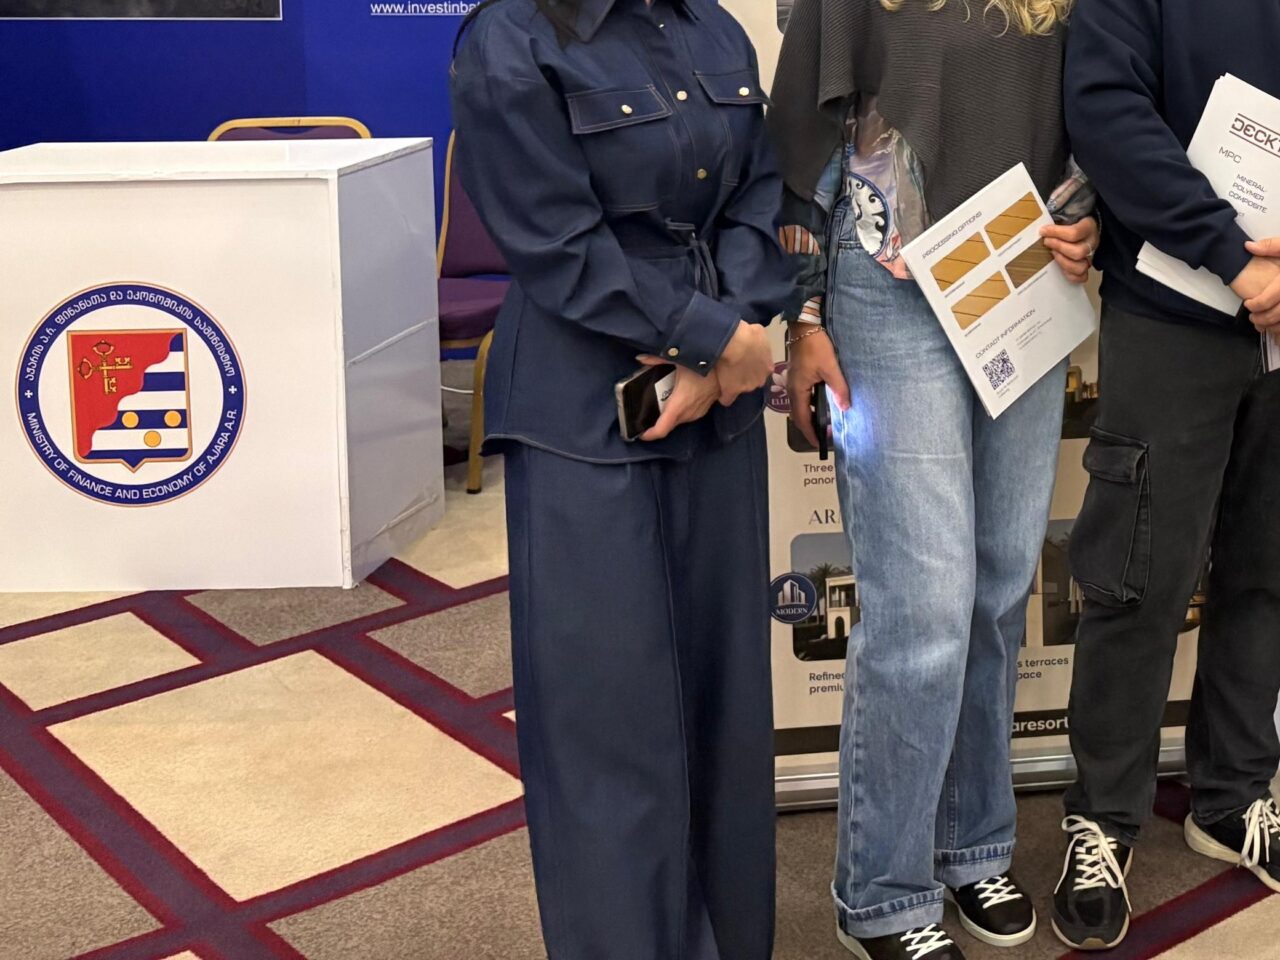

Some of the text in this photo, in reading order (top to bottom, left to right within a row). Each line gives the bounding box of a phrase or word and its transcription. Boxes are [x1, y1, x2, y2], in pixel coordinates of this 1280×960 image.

[1219, 146, 1242, 163] MPC
[1232, 182, 1265, 201] POLYMER
[1228, 190, 1268, 213] COMPOSITE
[110, 290, 123, 300] და
[27, 413, 57, 461] MINISTRY
[53, 457, 69, 472] OF
[68, 469, 113, 497] FINANCE
[115, 489, 140, 499] AND
[143, 474, 194, 499] ECONOMY
[192, 461, 207, 477] OF
[207, 431, 231, 466] AJARA
[804, 464, 834, 473] Three
[804, 477, 835, 487] panor
[809, 509, 841, 524] AR
[776, 608, 808, 616] MODERN
[1025, 656, 1069, 667] terraces
